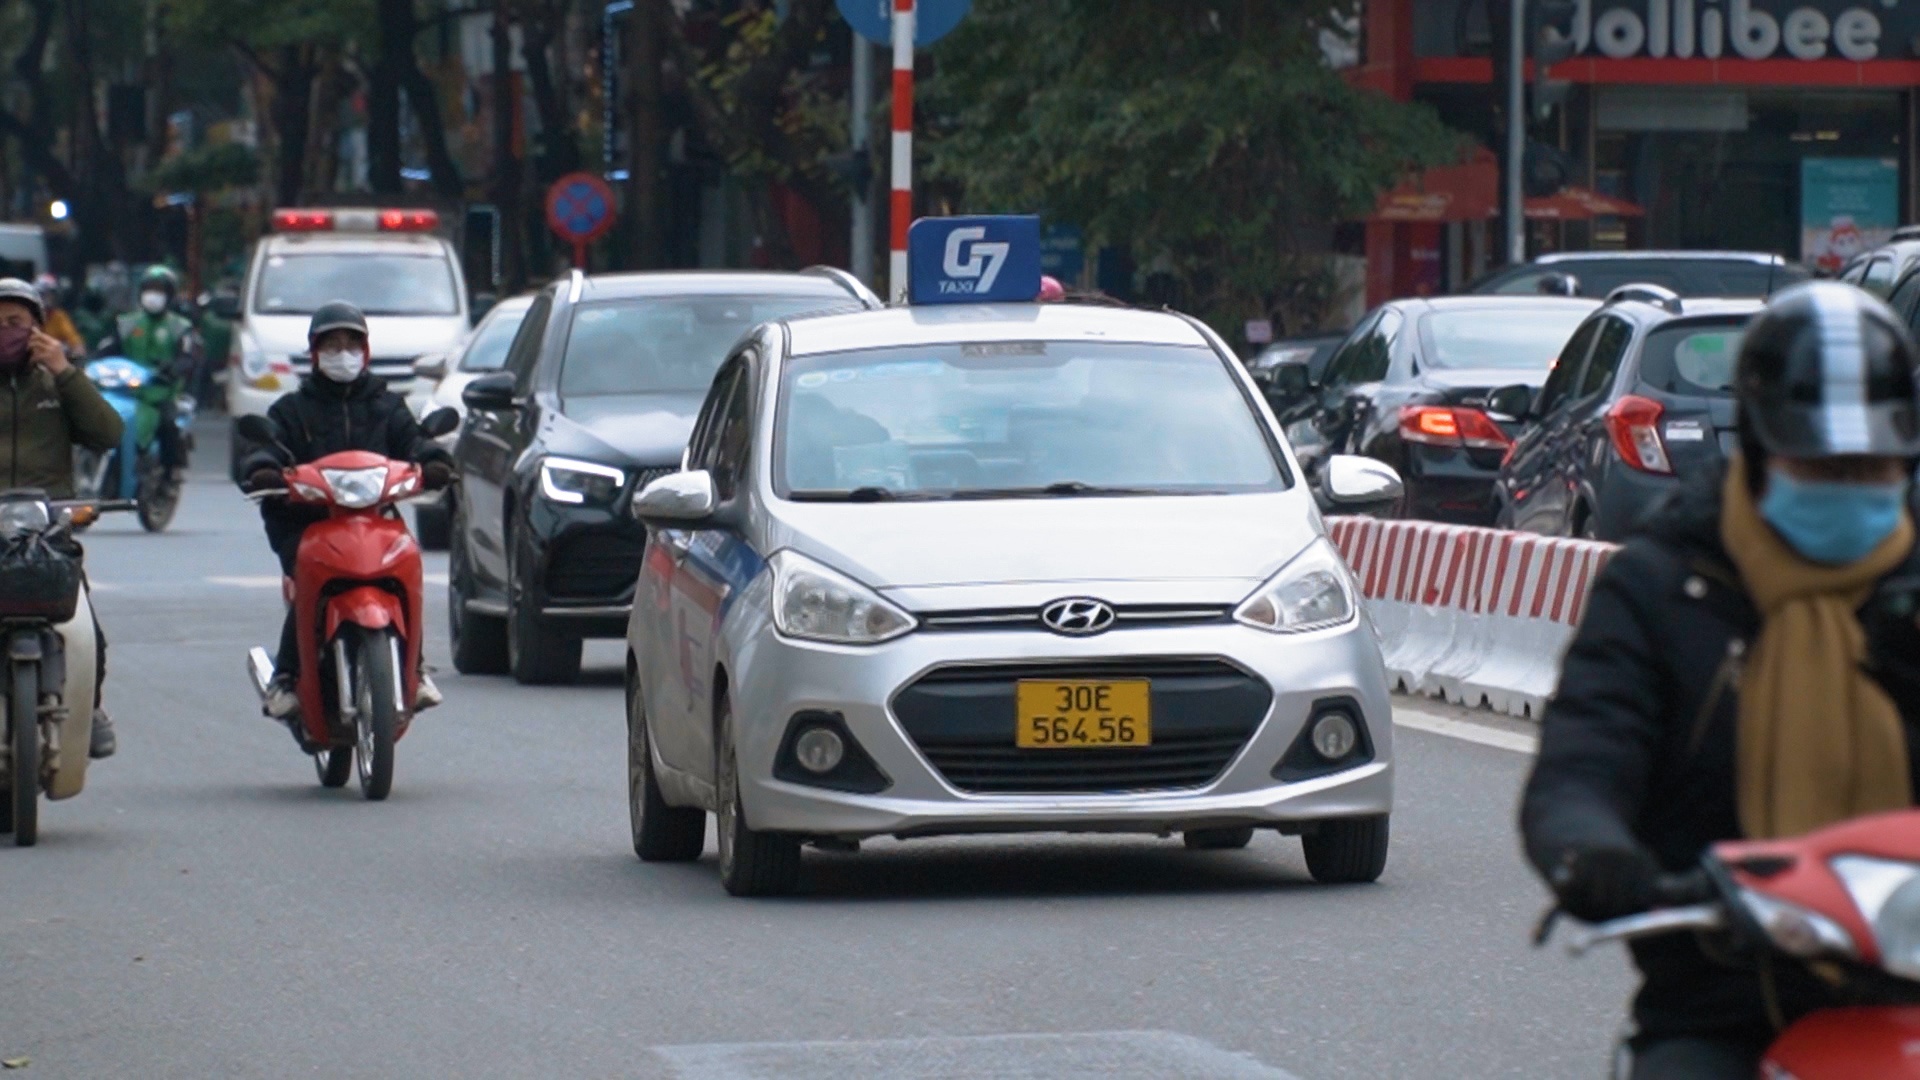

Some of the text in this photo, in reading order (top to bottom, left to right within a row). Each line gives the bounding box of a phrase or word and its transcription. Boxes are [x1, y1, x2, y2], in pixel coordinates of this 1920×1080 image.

[943, 226, 1010, 293] G7
[938, 280, 974, 294] TAXI
[1056, 686, 1111, 711] 30E
[1032, 716, 1135, 743] 564.56
